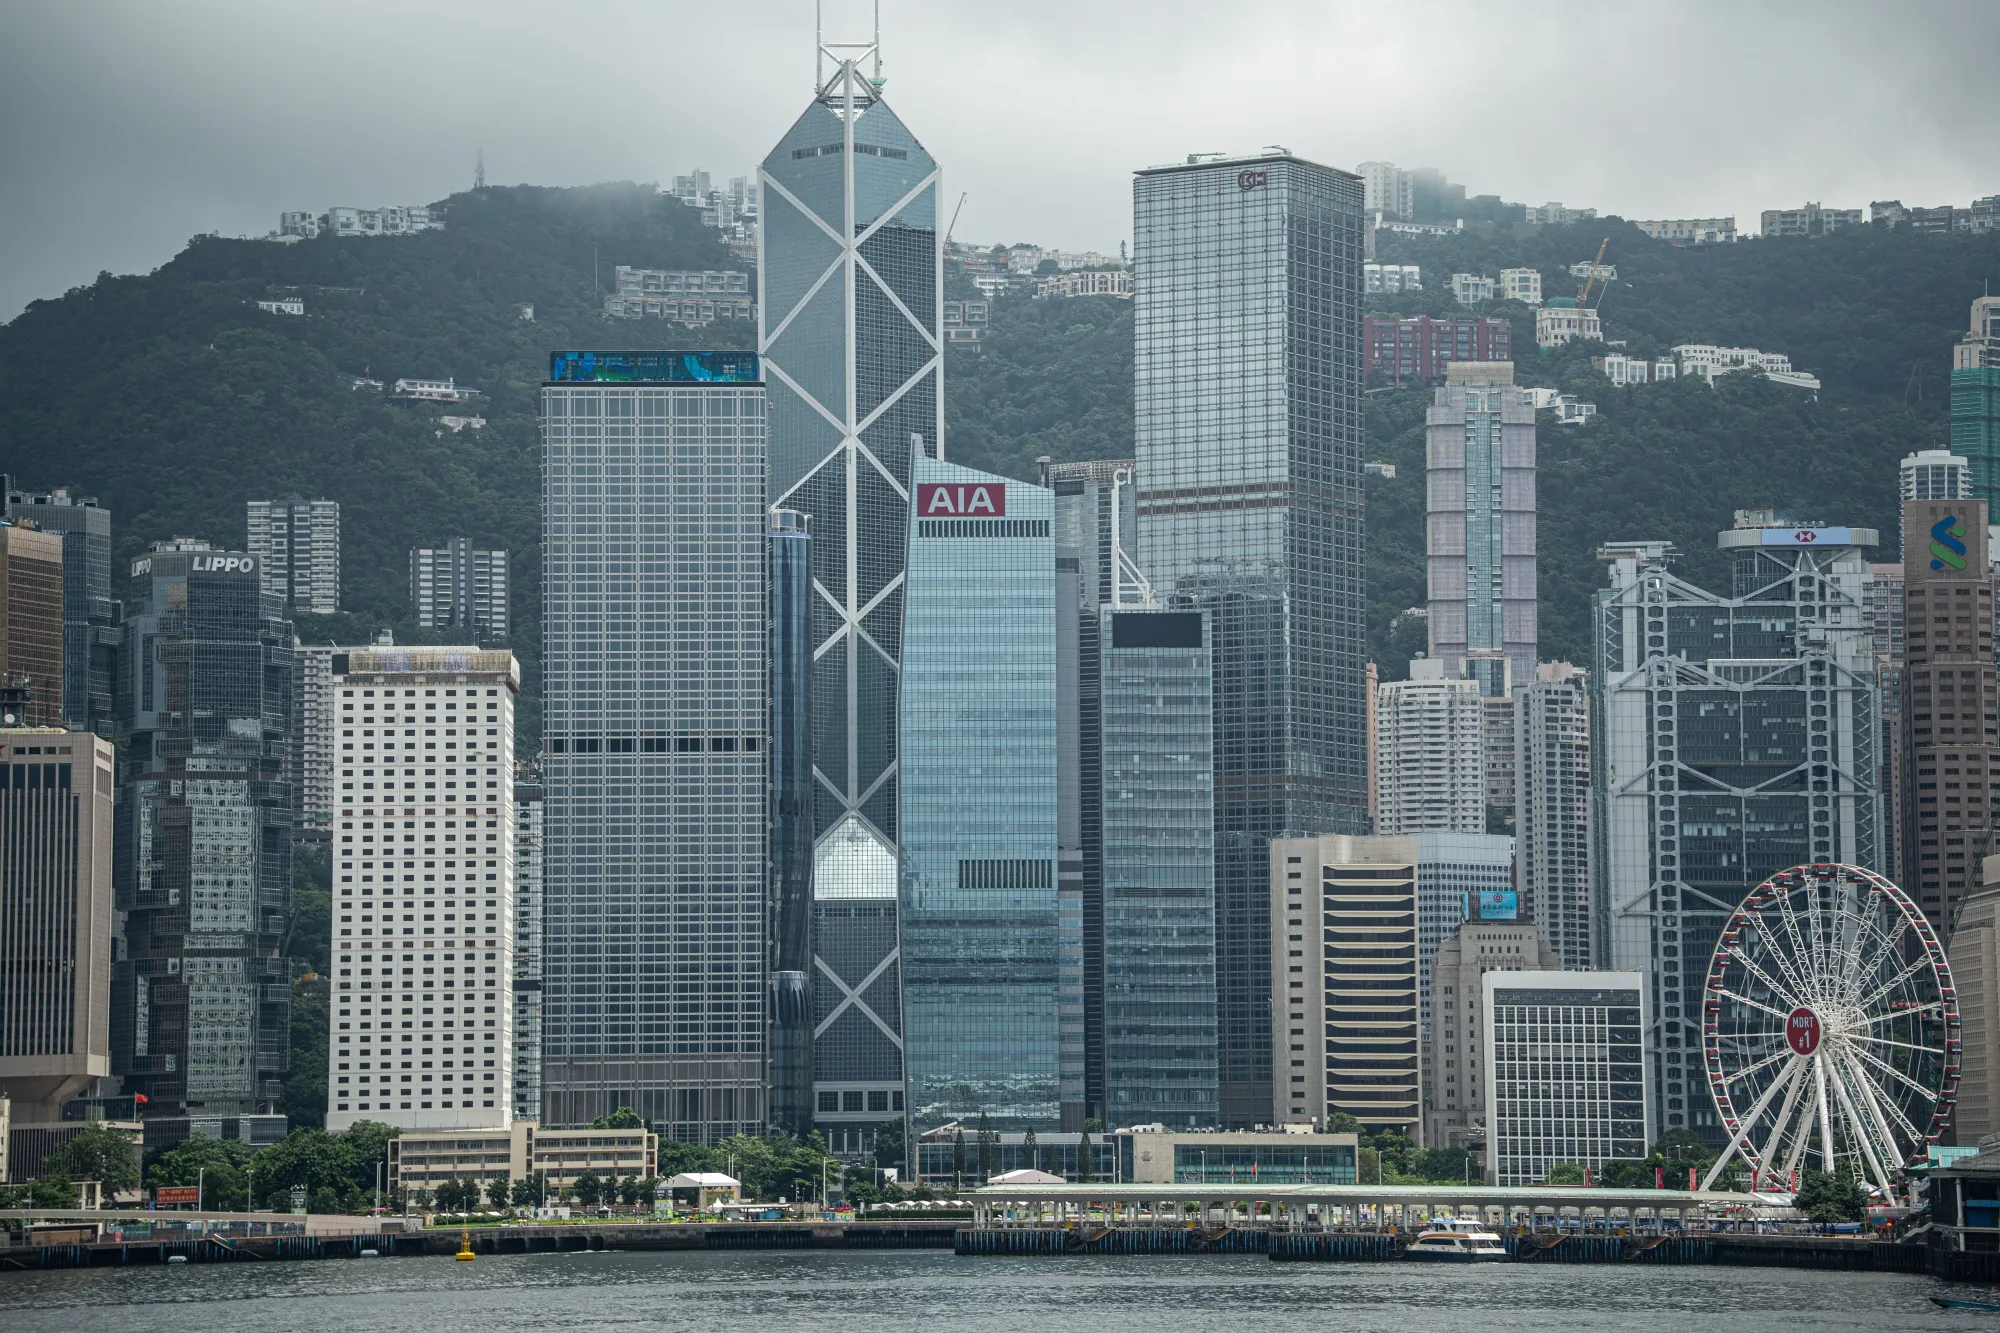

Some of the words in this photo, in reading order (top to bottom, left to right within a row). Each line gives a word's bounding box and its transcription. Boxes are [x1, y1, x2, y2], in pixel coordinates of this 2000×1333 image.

[927, 486, 996, 513] AIA
[131, 557, 152, 577] LIPPO
[192, 556, 254, 574] LIPPO
[1792, 1016, 1814, 1028] MDRT
[1798, 1029, 1810, 1048] #1
